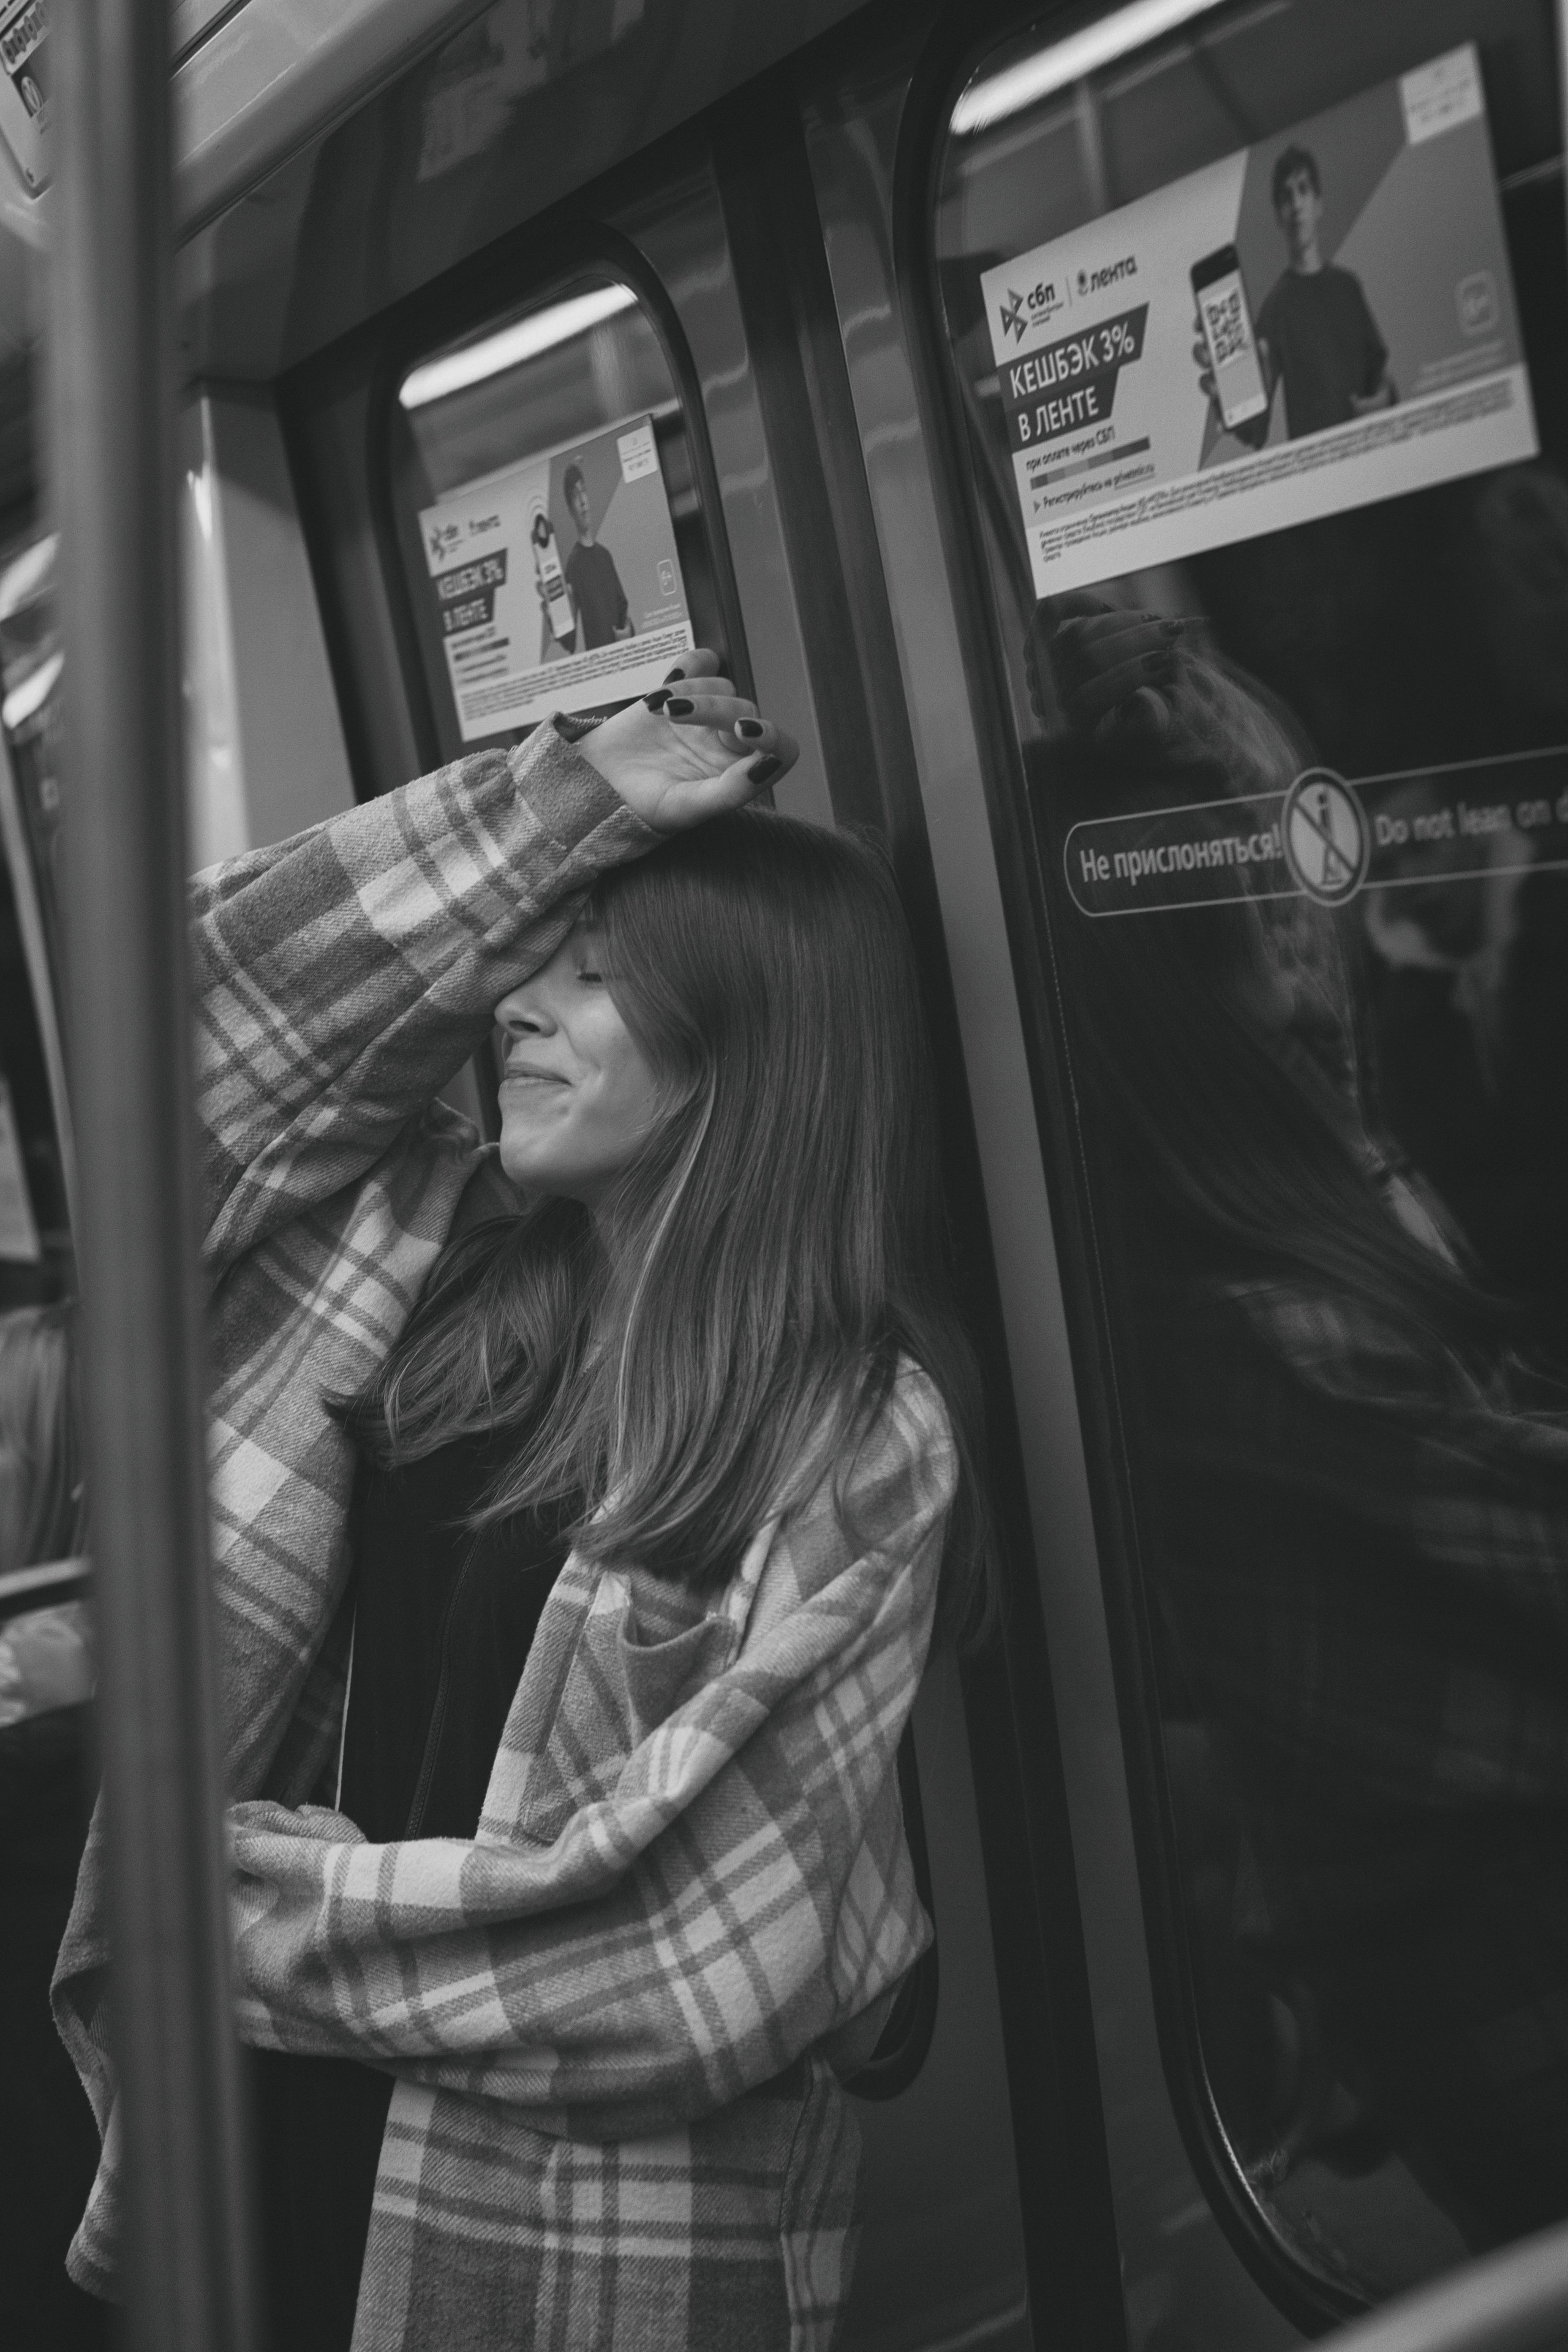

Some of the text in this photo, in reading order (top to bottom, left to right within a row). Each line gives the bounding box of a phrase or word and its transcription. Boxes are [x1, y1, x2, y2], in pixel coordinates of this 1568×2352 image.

[1027, 282, 1055, 310] сбп
[1090, 254, 1138, 292] лента
[1009, 320, 1136, 399] КЕШБЭК 3%
[1017, 385, 1100, 442] В ЛЕНТЕ
[1374, 812, 1409, 847] Do
[1413, 809, 1455, 842] not
[1457, 801, 1513, 837] lean
[1515, 799, 1552, 829] on
[1080, 823, 1284, 886] Не прислоняться!
